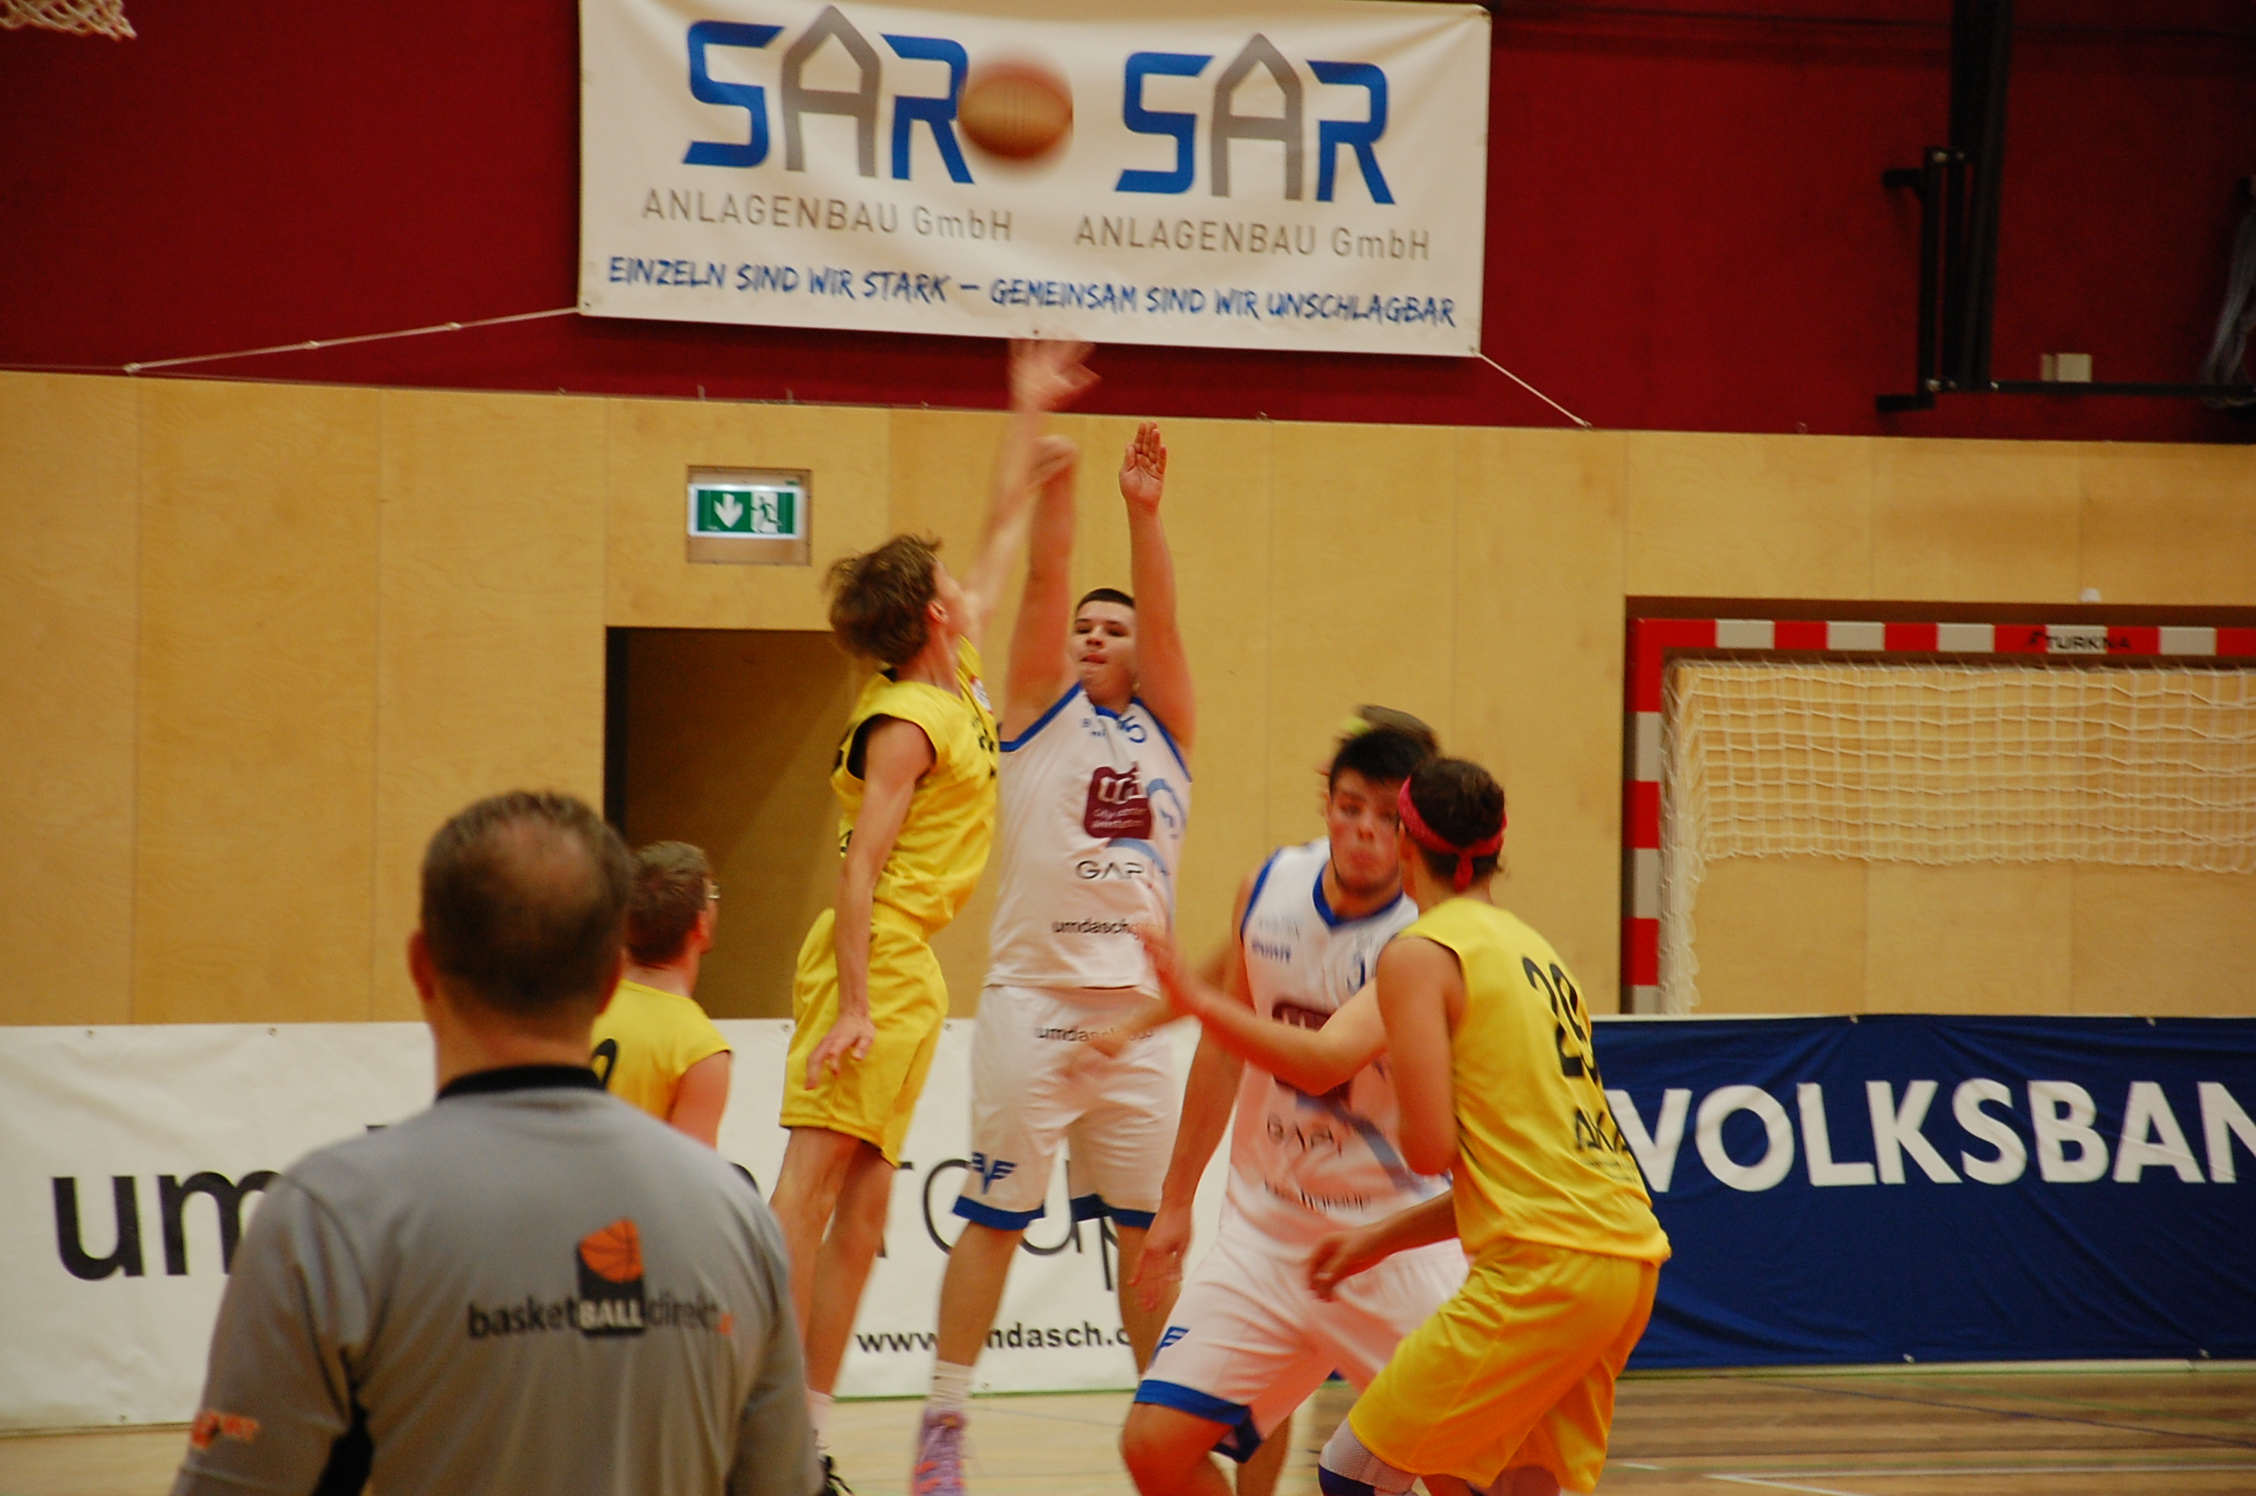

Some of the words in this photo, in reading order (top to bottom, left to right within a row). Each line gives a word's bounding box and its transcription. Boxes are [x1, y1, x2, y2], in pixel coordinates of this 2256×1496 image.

[682, 4, 975, 184] SAR
[1114, 33, 1396, 205] SAR
[642, 188, 898, 235] ANLAGENBAU
[913, 206, 1013, 242] GmbH
[1073, 215, 1316, 256] ANLAGENBAU
[1331, 226, 1430, 260] GmbH
[608, 255, 726, 289] EINZELN
[736, 263, 800, 294] SIND
[808, 266, 855, 300] WIR
[863, 270, 949, 303] STARK
[990, 278, 1138, 314] GEMEINSAM
[1146, 286, 1205, 314] SIND
[1213, 288, 1260, 319] WIR
[1267, 290, 1456, 327] UNSCHLAGBAR
